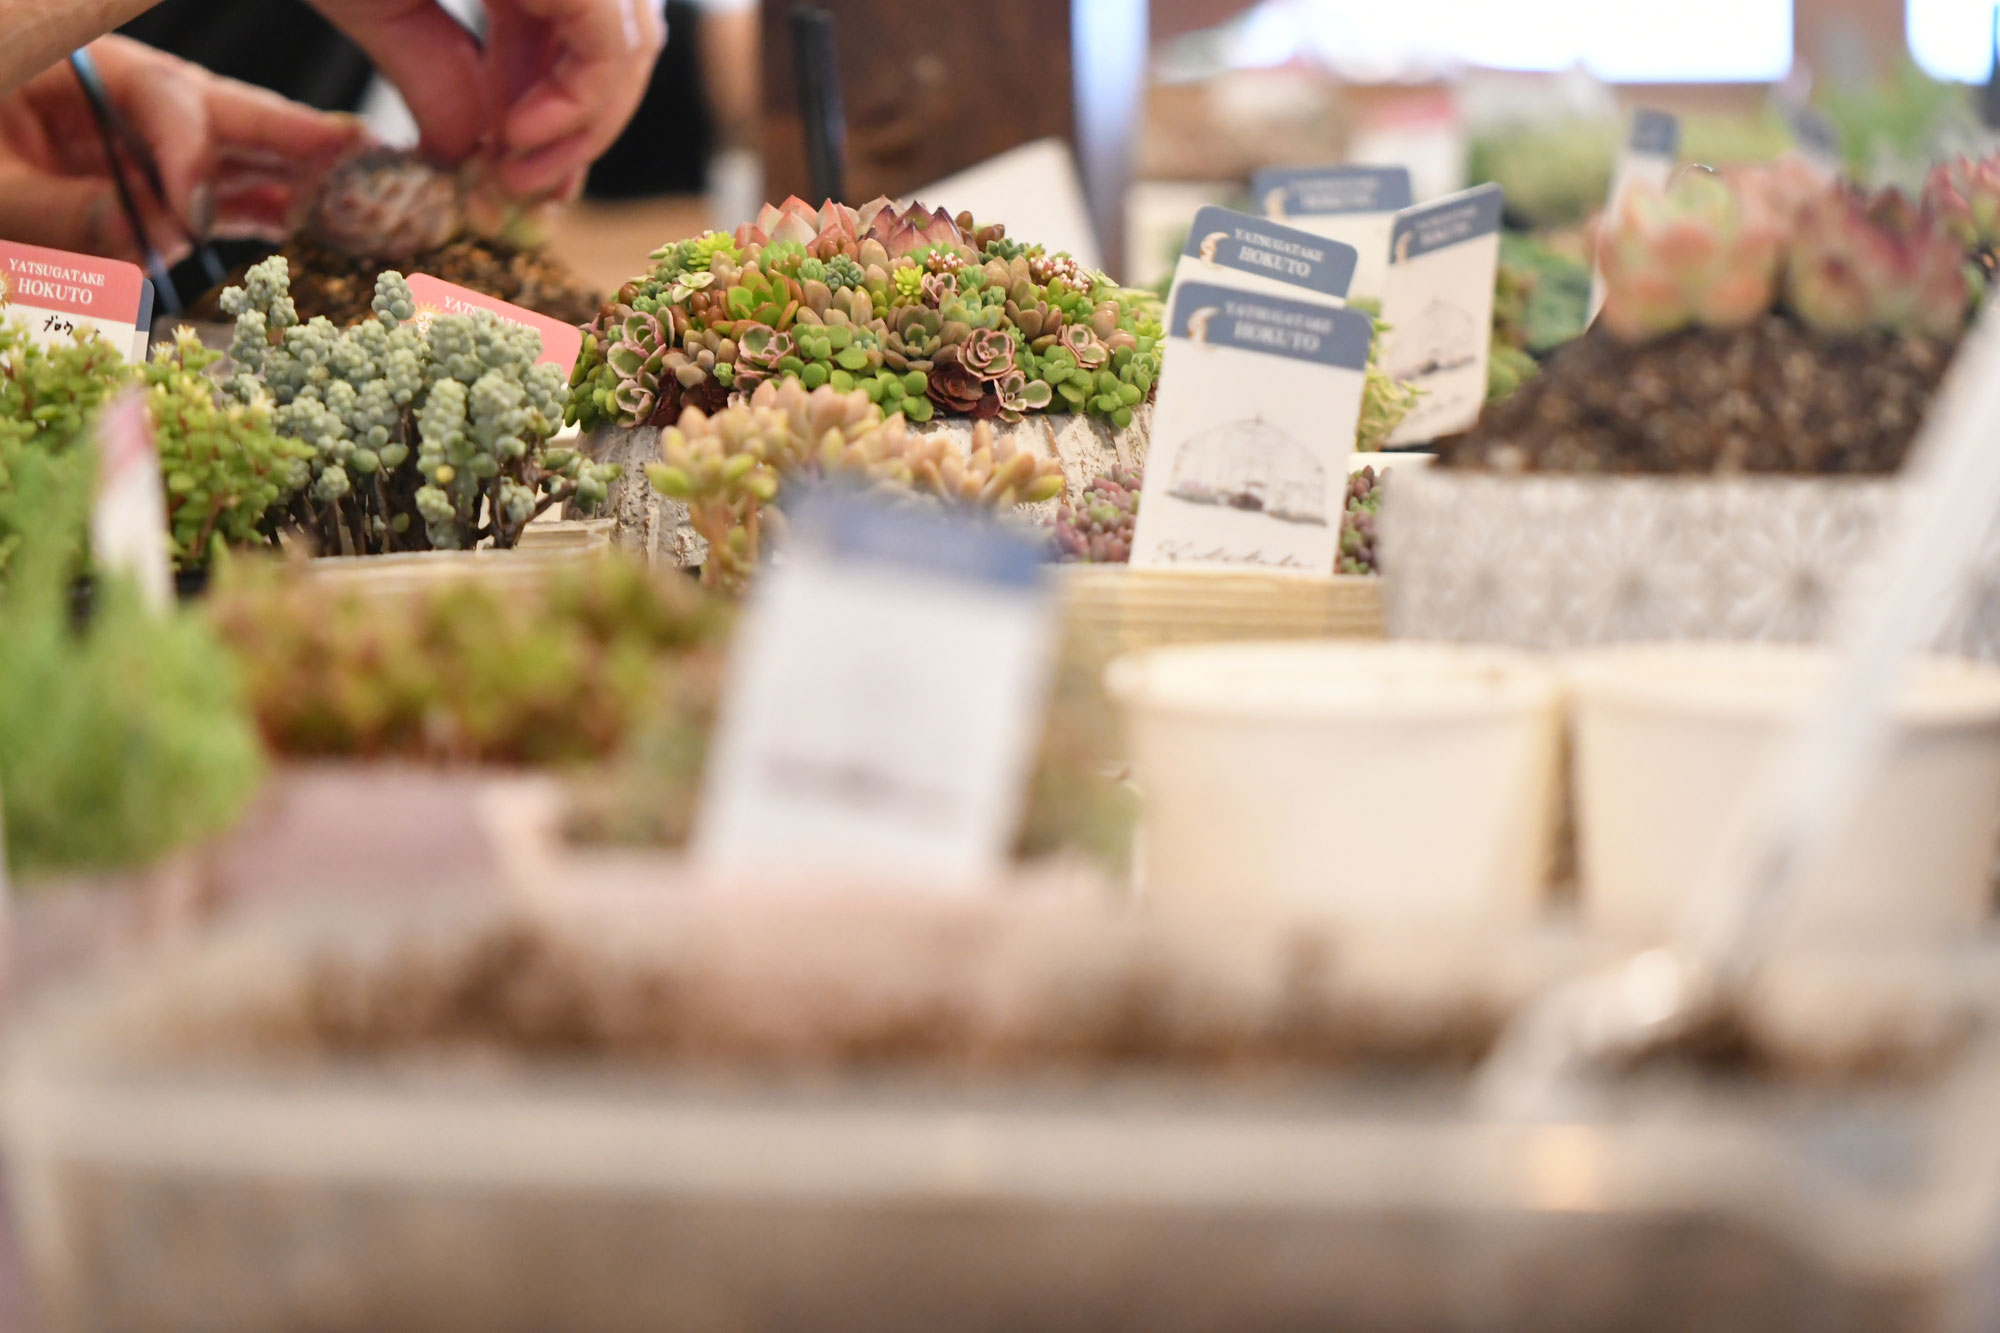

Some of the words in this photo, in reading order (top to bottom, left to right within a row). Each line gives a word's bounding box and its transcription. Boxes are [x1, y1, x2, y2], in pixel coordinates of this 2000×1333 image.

[9, 257, 105, 287] YATSUGATAKE
[1239, 245, 1312, 278] HOKUTO
[18, 277, 93, 305] HOKUTO
